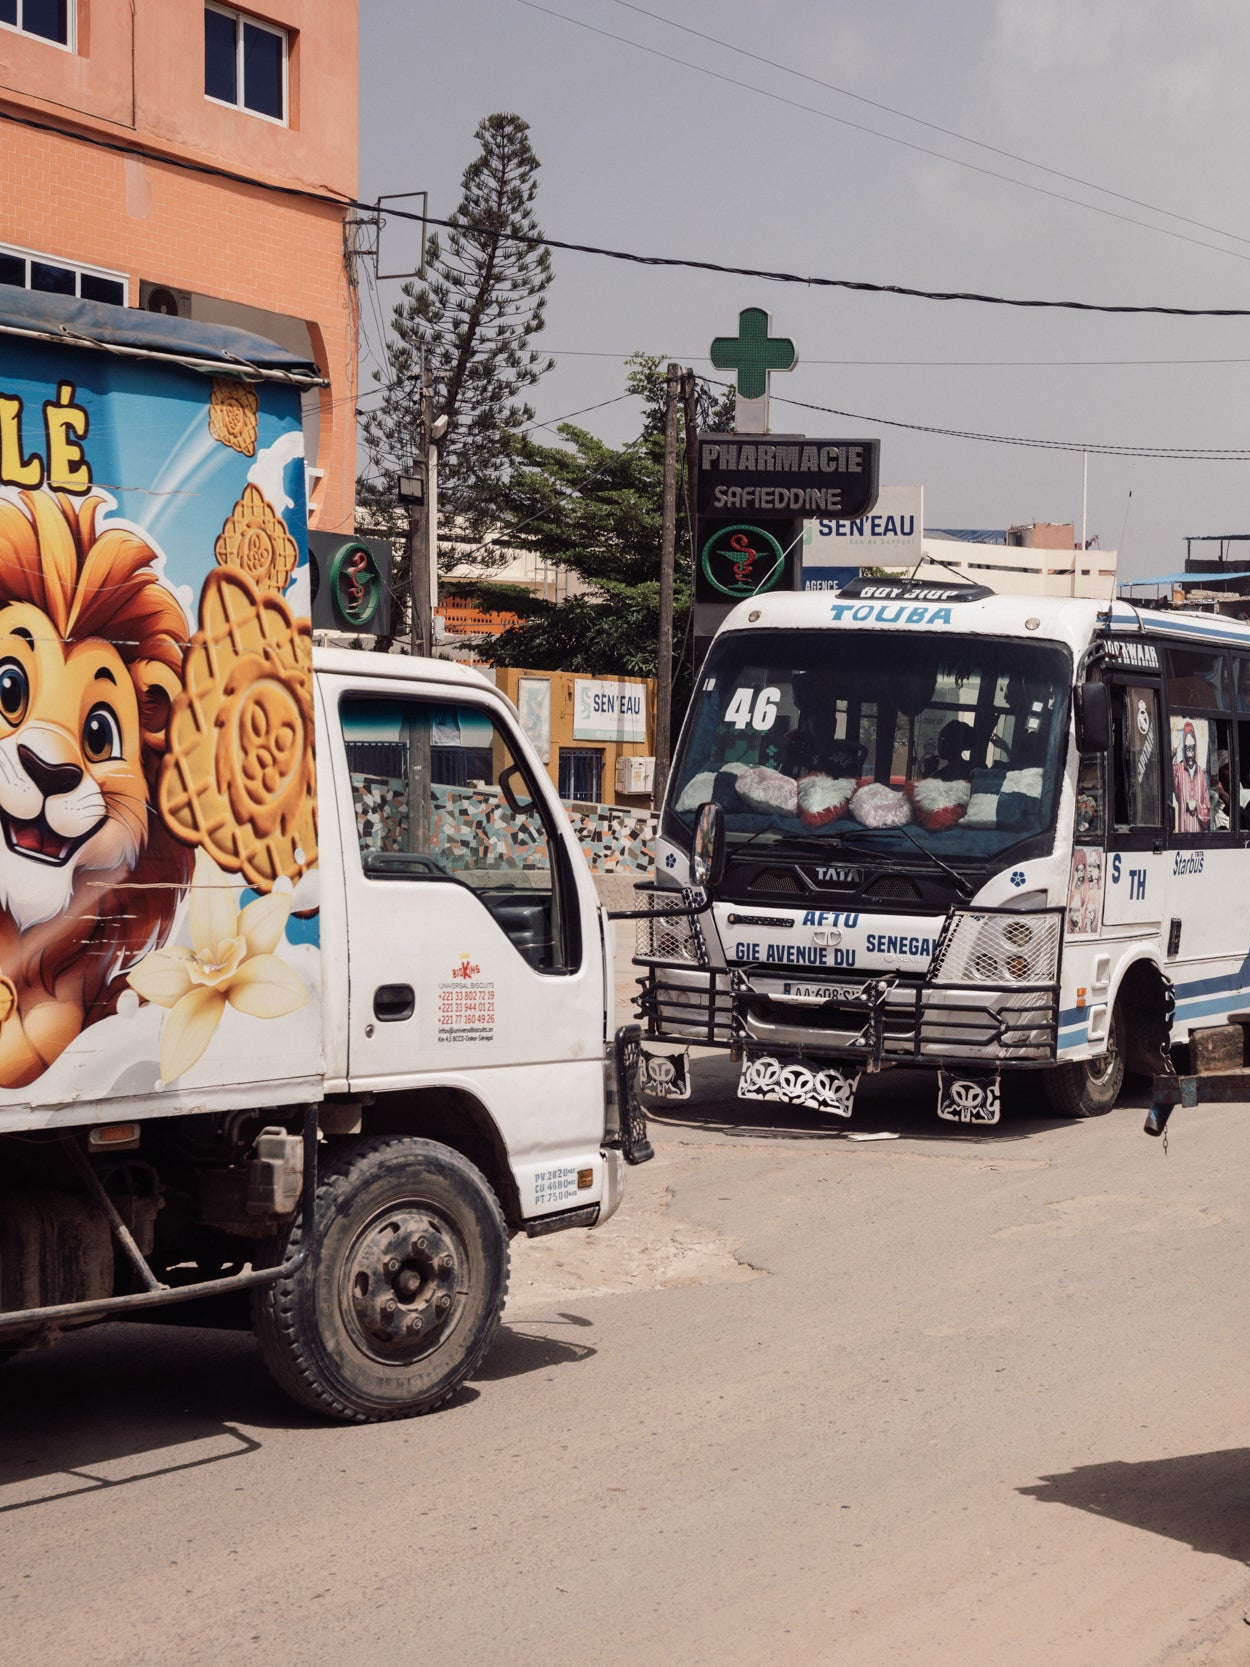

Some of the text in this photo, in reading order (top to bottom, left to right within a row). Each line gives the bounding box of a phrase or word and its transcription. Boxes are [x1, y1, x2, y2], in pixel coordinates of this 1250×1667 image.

[702, 444, 864, 473] PHARMACIE
[714, 485, 842, 511] SAFIEDDINE
[819, 515, 914, 537] SEN'EAU
[805, 580, 839, 591] AGENCE
[860, 586, 902, 599] BOY
[830, 604, 954, 625] TOUBA
[593, 693, 641, 715] SEN'EAU
[724, 687, 781, 731] 46
[1112, 853, 1122, 884] S
[1173, 851, 1204, 876] Starbus
[816, 867, 860, 883] TATA
[1129, 869, 1147, 900] TH
[802, 911, 859, 928] AFTU
[736, 942, 760, 961] GIE
[766, 944, 827, 965] AVENUE
[834, 948, 856, 967] DU
[452, 961, 480, 979] BISKING
[438, 991, 495, 1000] +221 33 802 72 19
[438, 1002, 495, 1012] +221 33 944 01 21
[438, 1014, 495, 1024] +221 77 160 49 26
